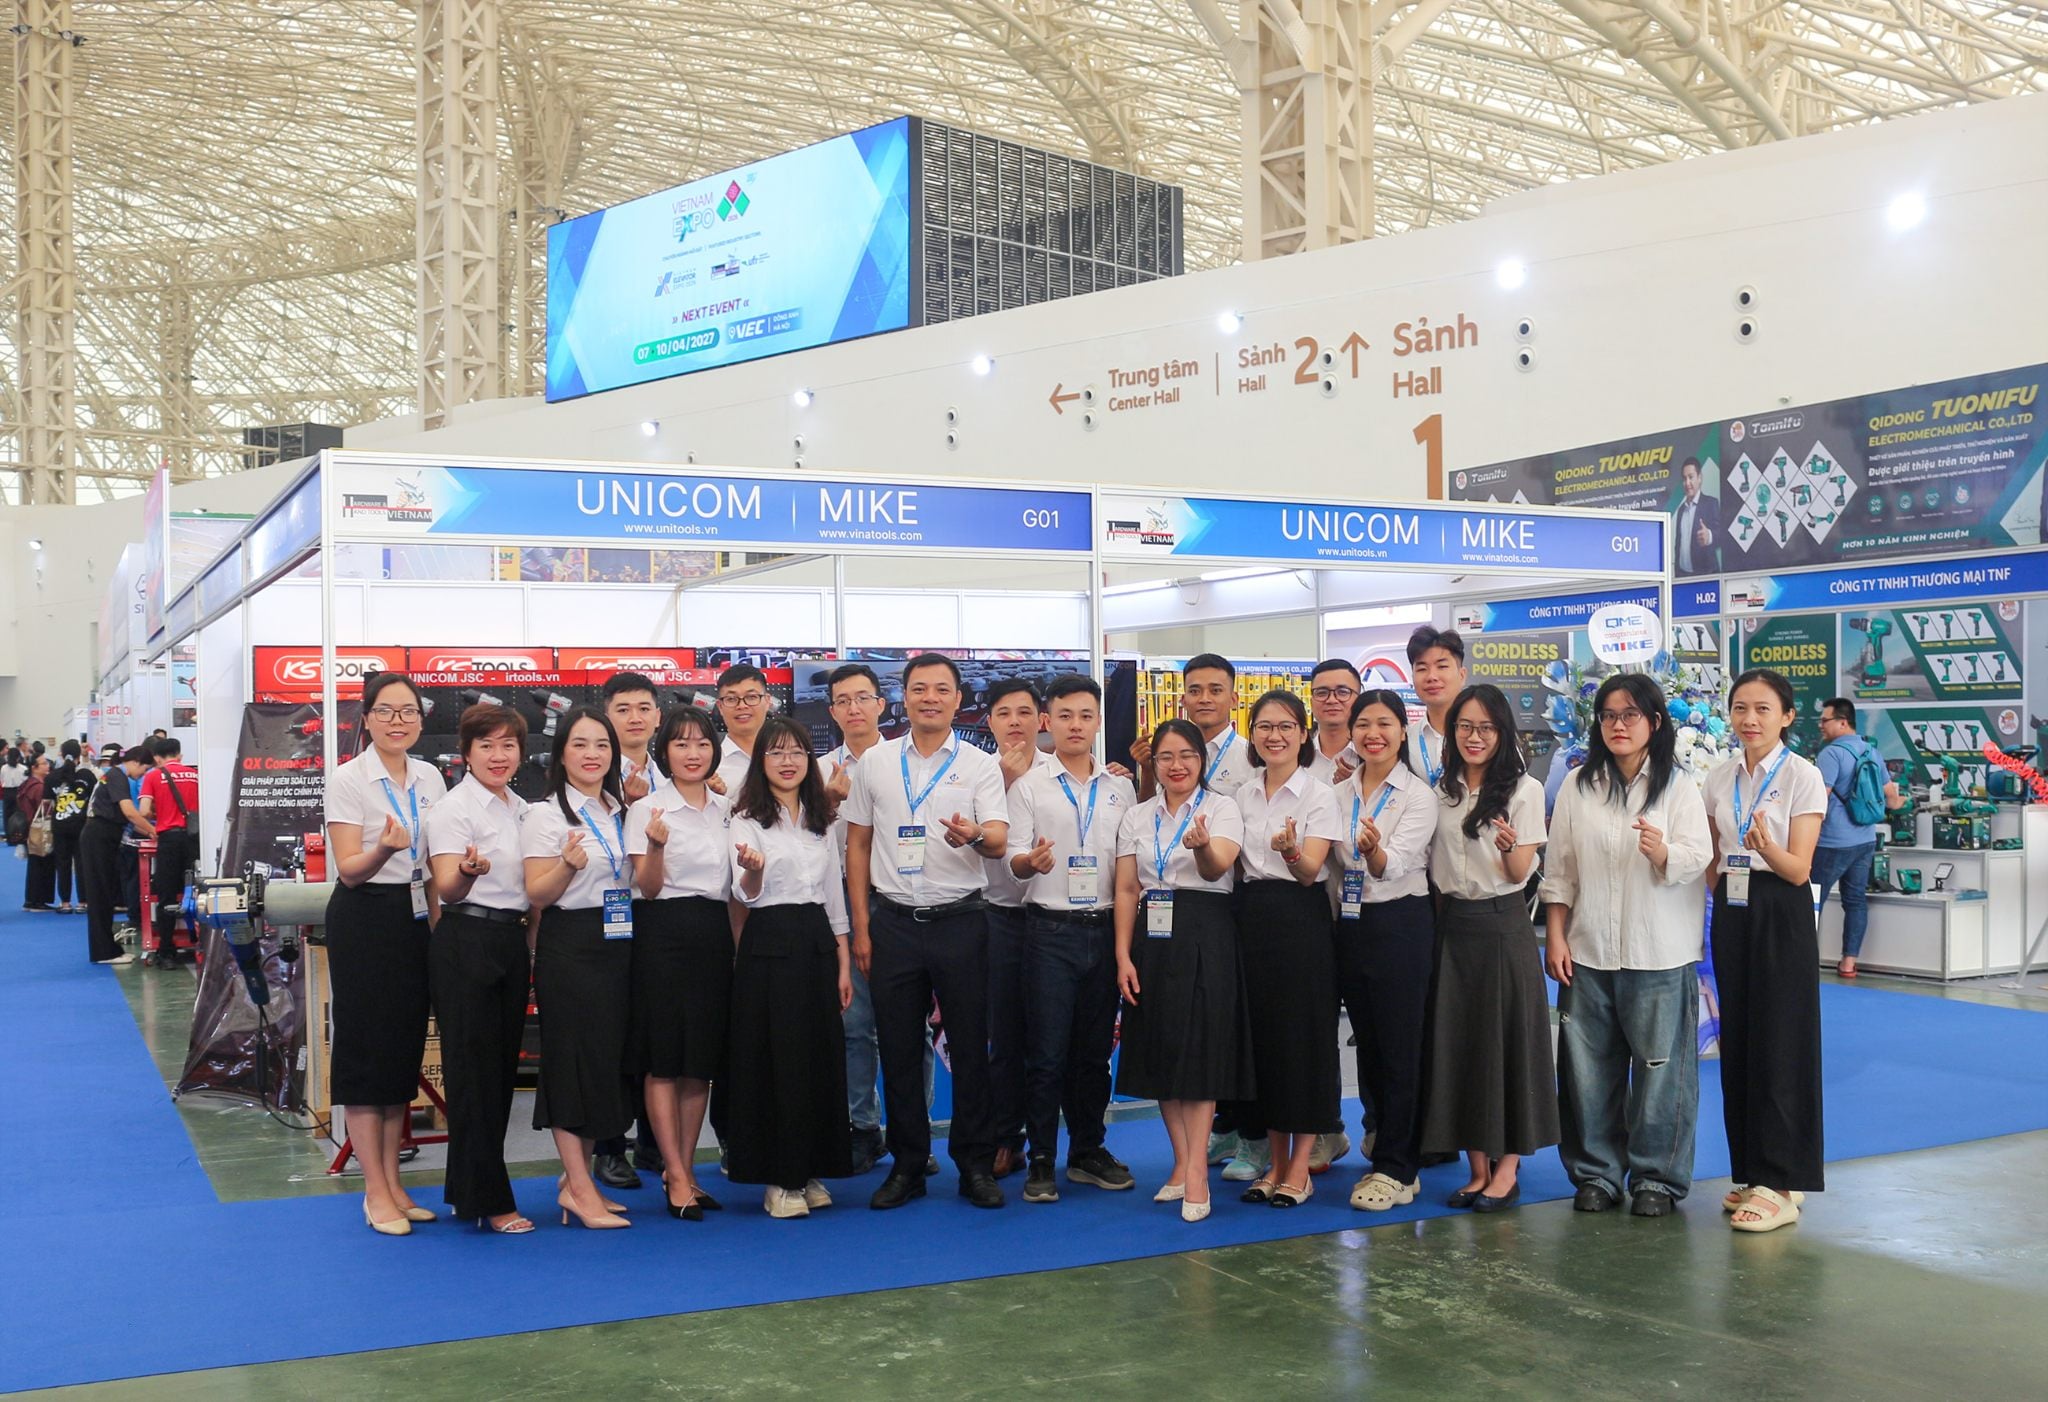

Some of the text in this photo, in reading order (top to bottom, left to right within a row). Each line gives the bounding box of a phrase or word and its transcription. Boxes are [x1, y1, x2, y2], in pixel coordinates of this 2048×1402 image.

[672, 192, 714, 215] VIETNAM
[673, 208, 715, 242] EXPO
[681, 298, 742, 323] NEXT EVENT
[735, 319, 766, 339] VEC
[1392, 312, 1478, 358] Sảnh
[1238, 336, 1319, 385] Sảnh 2
[1108, 358, 1199, 391] Trung tâm
[1238, 375, 1266, 394] Hall
[1393, 366, 1442, 399] Hall
[1108, 388, 1180, 412] Center Hall
[1868, 384, 2038, 431] QIDONG TUONIFU
[1868, 420, 1986, 448] ELECTROMECHANICAL
[1412, 413, 1442, 500] 1
[1555, 446, 1673, 482] QIDONG TUONIFU
[1868, 466, 1891, 478] Được
[1893, 461, 1910, 476] giới
[1912, 458, 1935, 472] thiệu
[1938, 456, 1957, 468] trên
[1992, 448, 2015, 460] hình
[1554, 473, 1637, 496] ELECTROMECHANICAL
[576, 478, 1059, 530] UNICOM MIKE G01
[388, 509, 432, 520] VIETNAM
[624, 522, 923, 541] www.unitools.vn www.vinatools.com
[1140, 534, 1174, 543] VIETNAM
[1281, 507, 1640, 553] UNICOM MIKE G01
[1842, 528, 1970, 549] HƠN 10 NĂM KINH NGHIỆM
[1317, 547, 1539, 565] www.unitools.vn www.vinatools.com
[1829, 567, 2011, 595] CÔNG TY TNHH THƯƠNG MẠI TNF
[1695, 592, 1716, 605] H.02
[1529, 605, 1552, 619] CÔNG
[1552, 606, 1562, 617] TY
[1562, 604, 1586, 616] TNHH
[1605, 615, 1643, 628] QME
[1472, 642, 1559, 660] CORDLESS
[1602, 639, 1654, 653] MIKE
[1750, 643, 1827, 663] CORDLESS
[410, 673, 457, 683] UNICOM
[461, 673, 484, 683] JSC
[505, 672, 560, 682] irtools.vn
[668, 672, 692, 681] JSC
[1238, 665, 1271, 674] HARDWARE
[1271, 665, 1291, 673] TOOLS
[1472, 663, 1517, 676] POWER
[1791, 664, 1827, 677] TOOLS
[243, 757, 263, 770] QX
[264, 756, 313, 769] Connect
[242, 775, 255, 785] GIẢI
[256, 775, 274, 785] PHÁP
[290, 774, 307, 785] SOÁT
[240, 787, 268, 796] BULONG
[293, 786, 312, 796] CHÍNH
[238, 797, 319, 808] CHO NGÀNH CÔNG NGHIỆP
